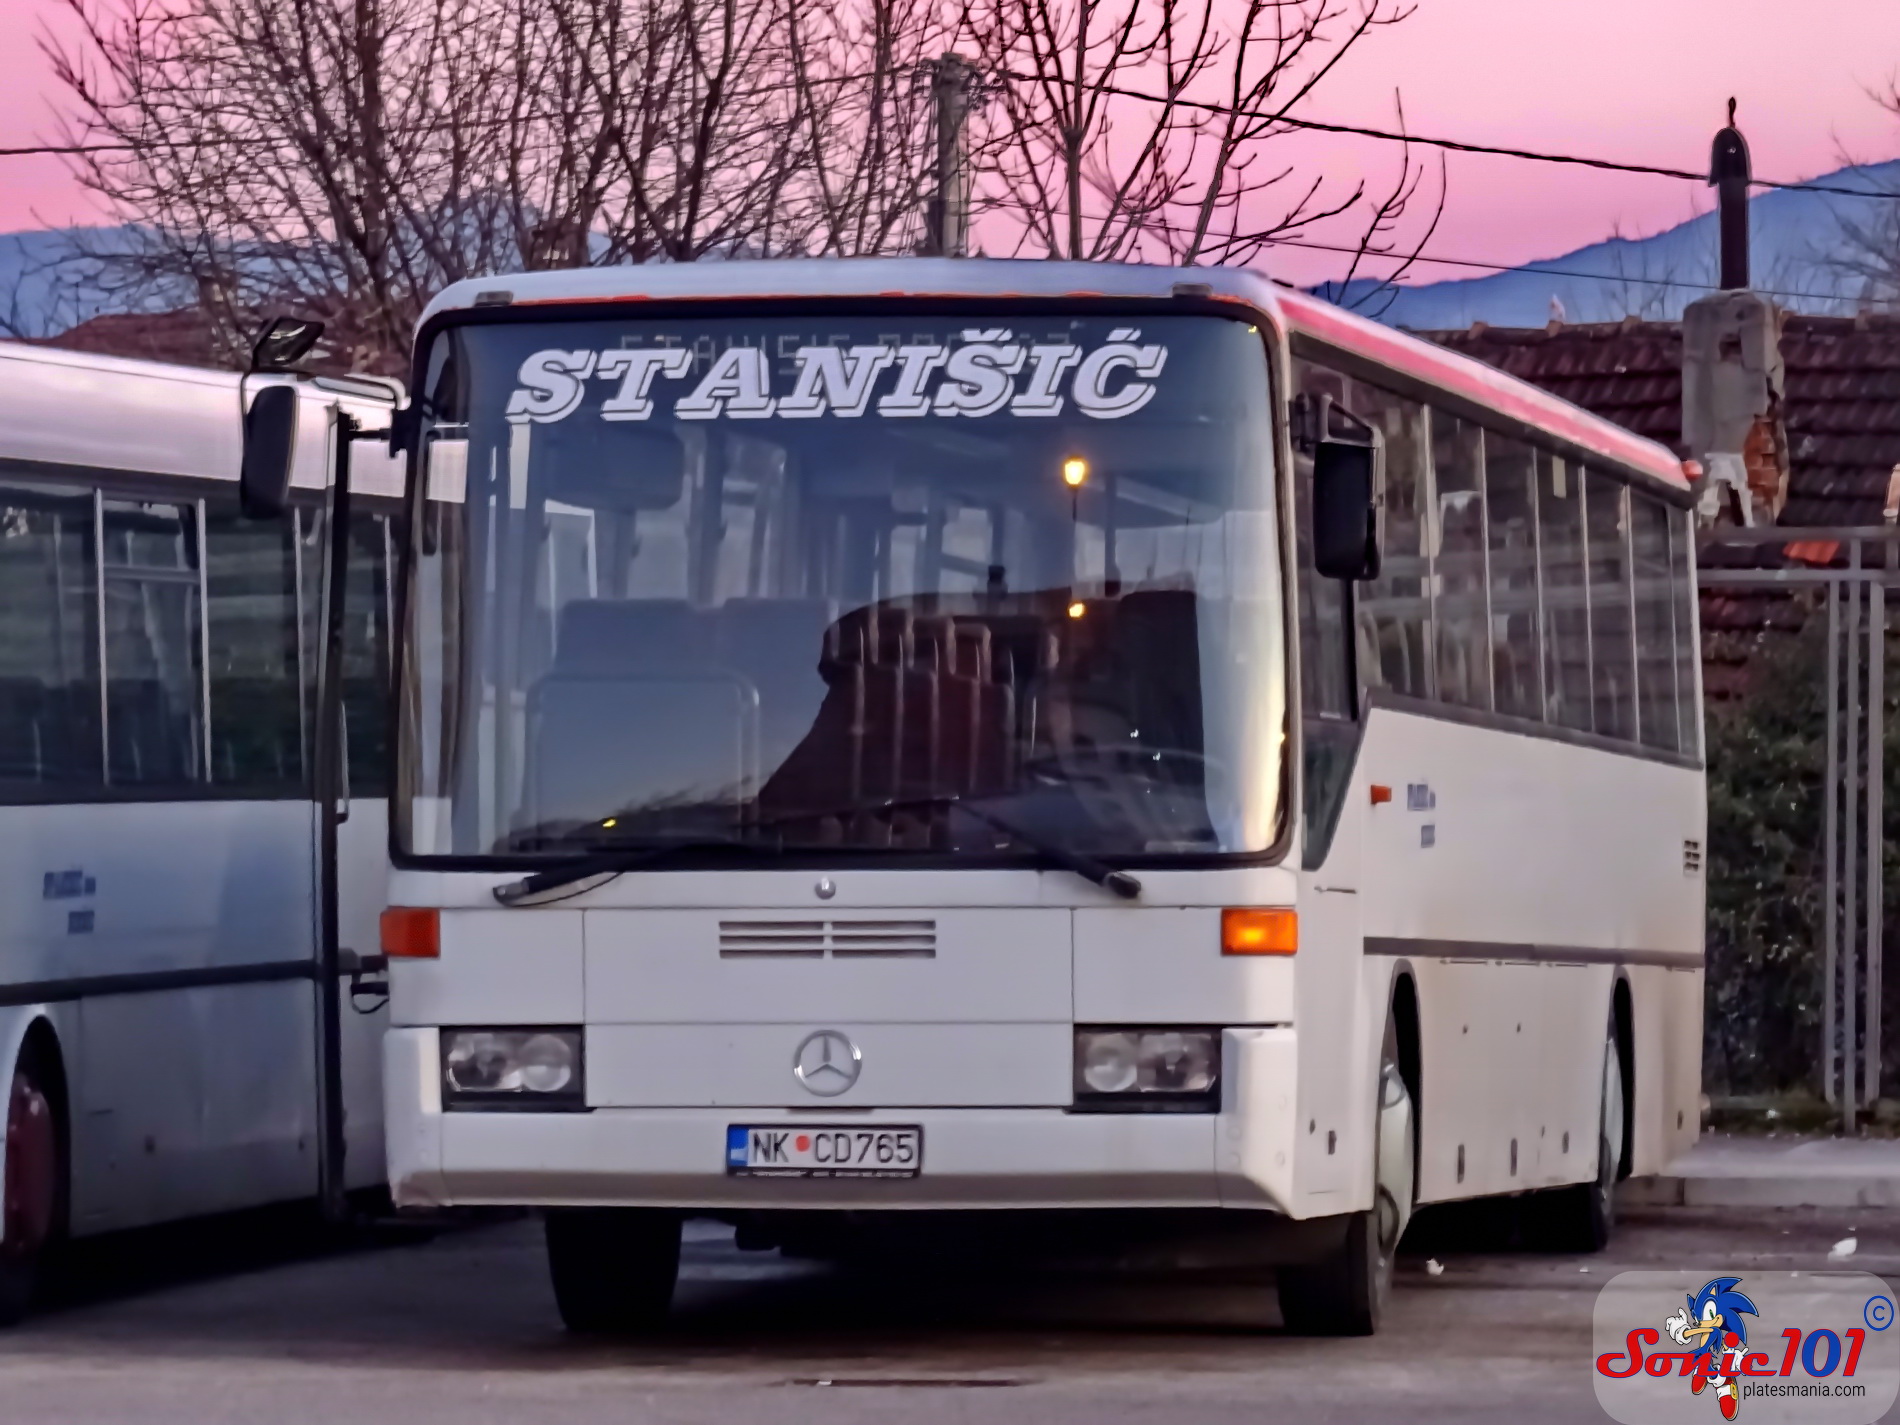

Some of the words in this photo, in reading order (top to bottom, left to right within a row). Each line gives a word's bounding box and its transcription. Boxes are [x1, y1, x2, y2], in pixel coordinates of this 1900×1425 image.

[505, 328, 1168, 422] STANIŠIĆ
[752, 1132, 790, 1163] NK
[814, 1132, 914, 1164] CD765
